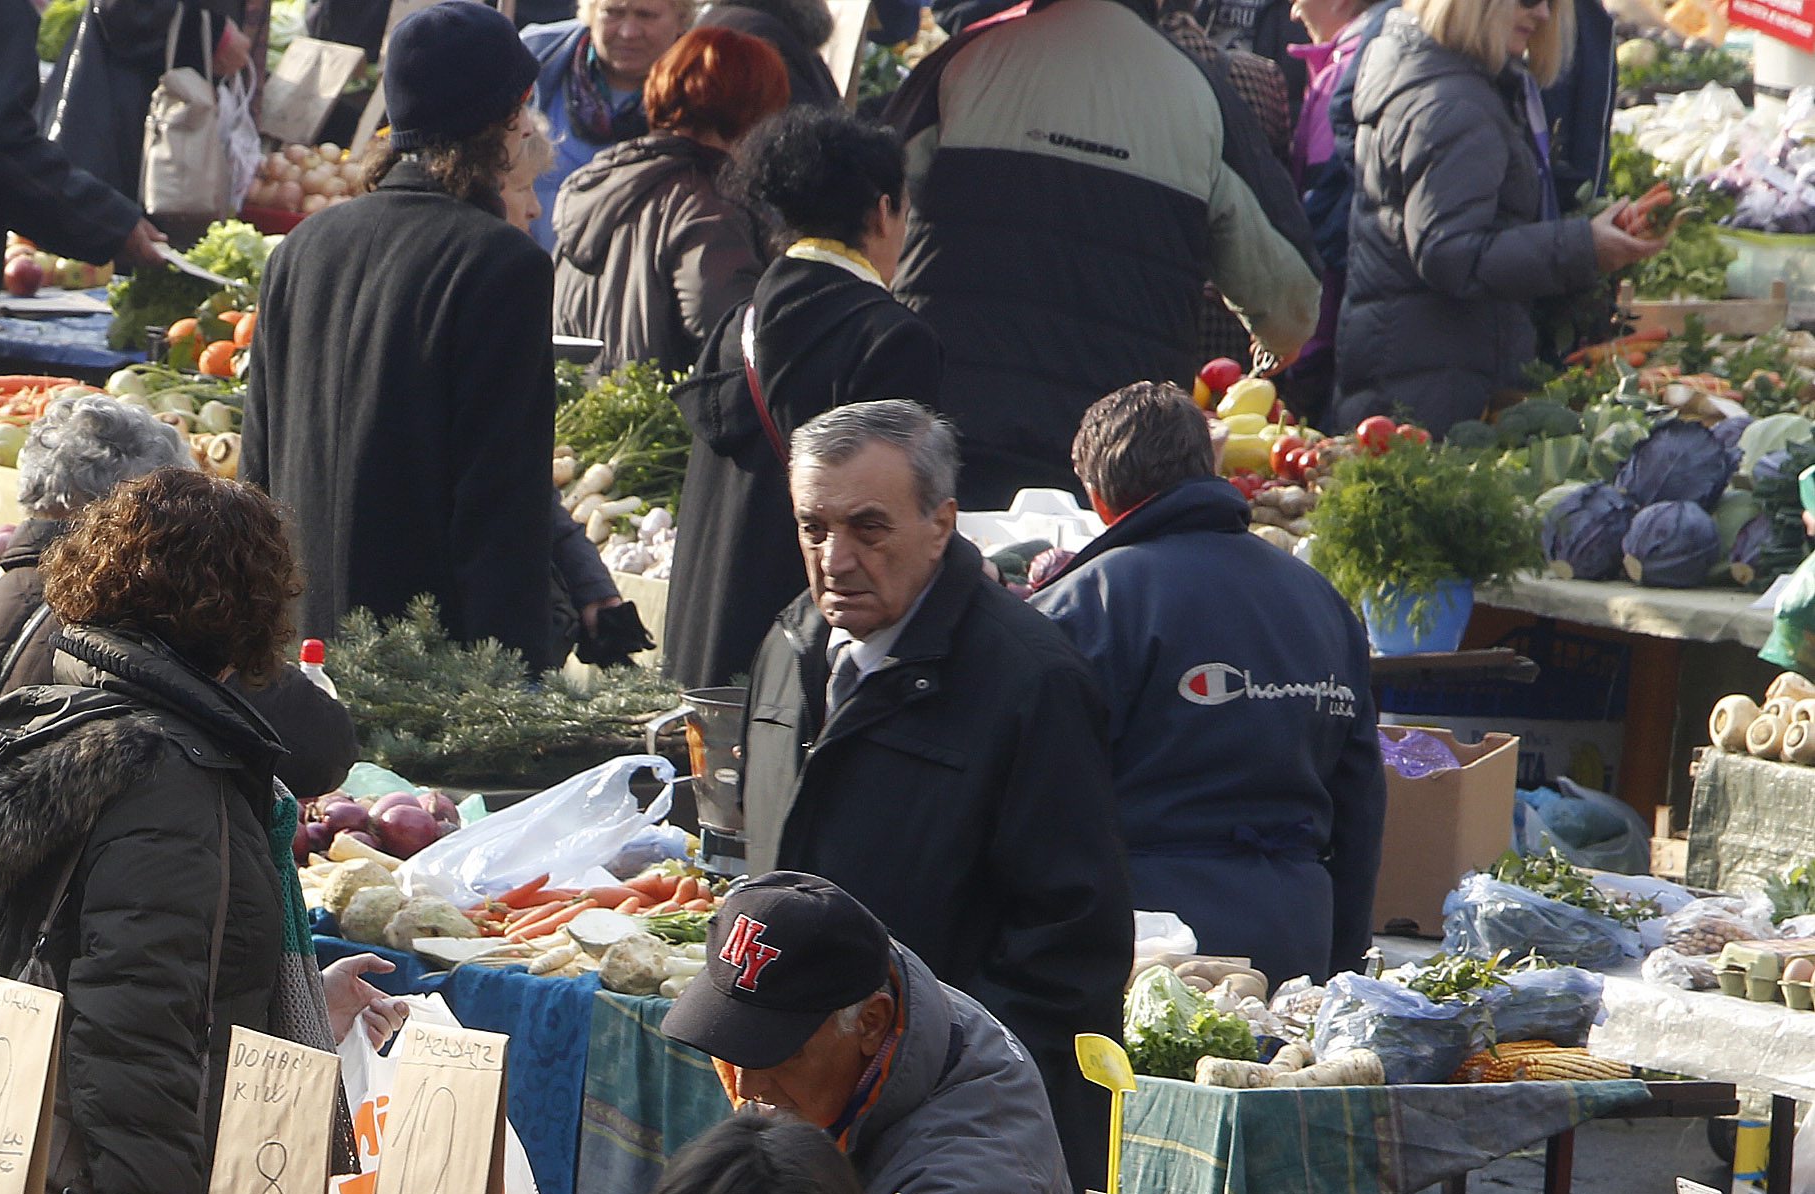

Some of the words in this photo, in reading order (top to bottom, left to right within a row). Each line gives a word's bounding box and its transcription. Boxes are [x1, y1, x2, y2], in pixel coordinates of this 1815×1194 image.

[1048, 132, 1129, 160] UMBRO
[718, 913, 782, 992] NY
[234, 1081, 301, 1108] KIWI
